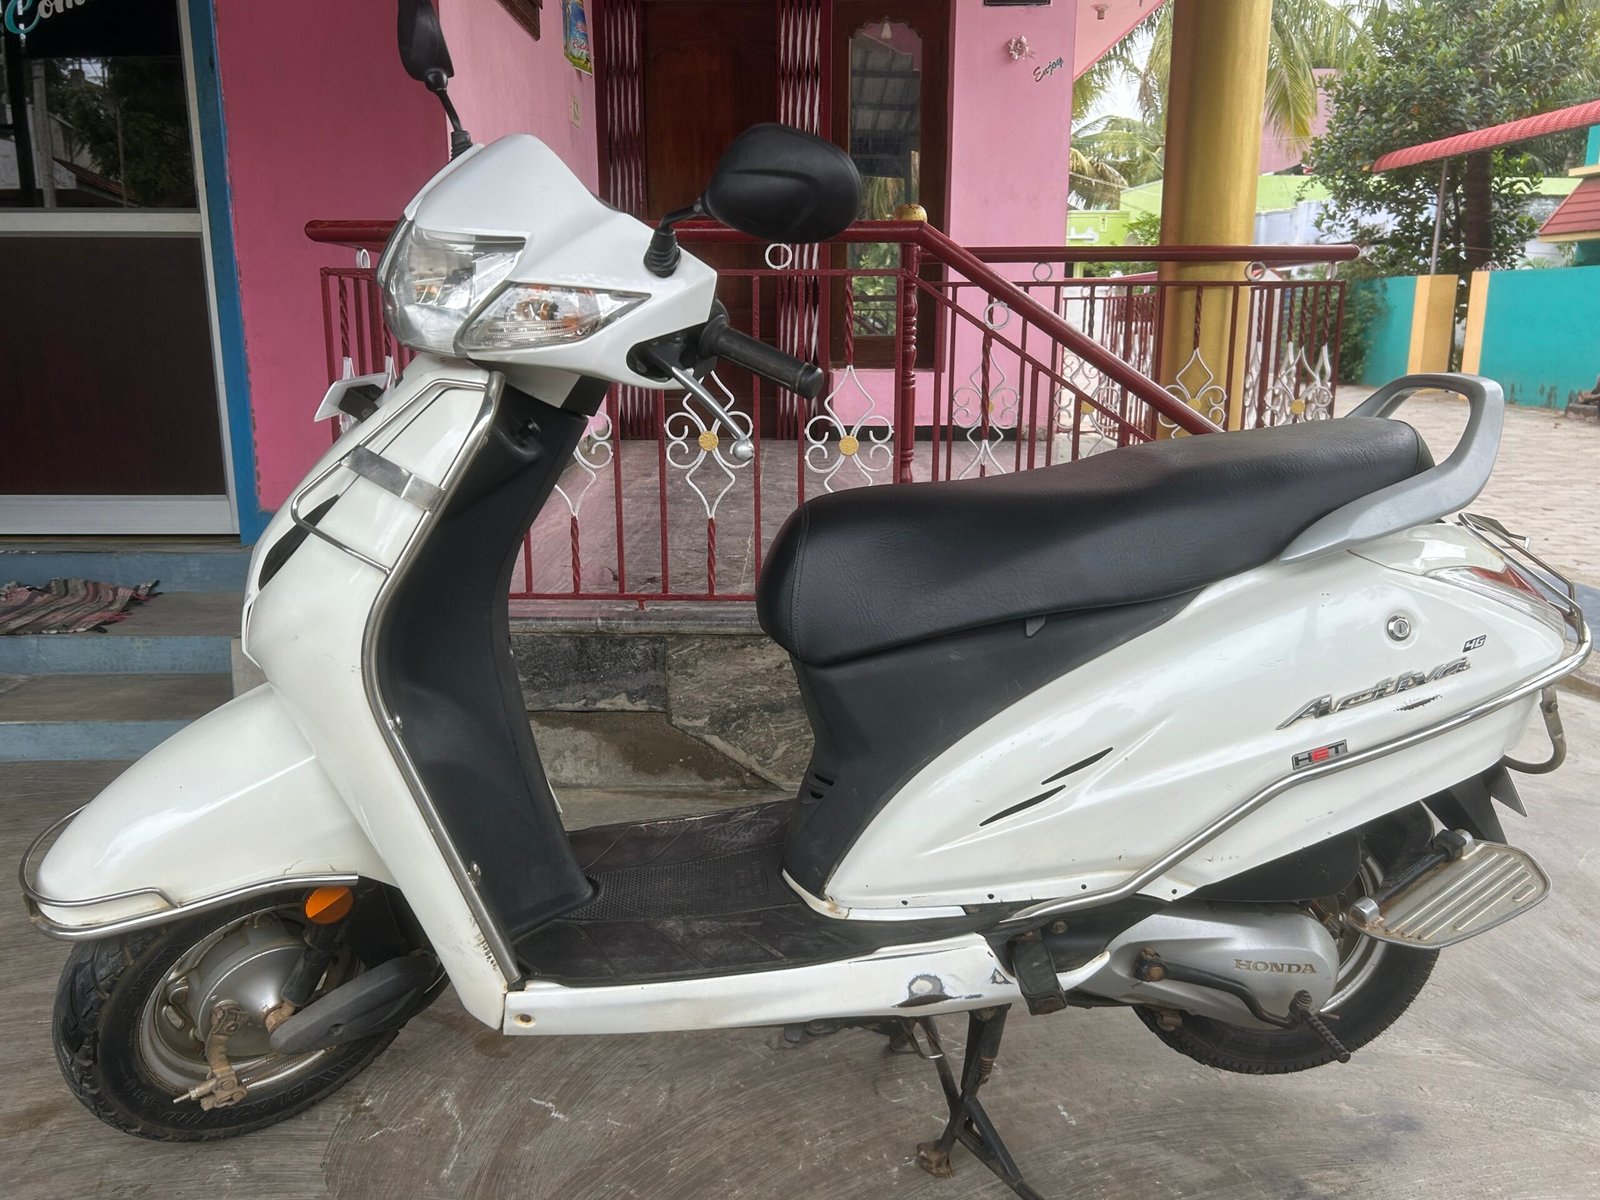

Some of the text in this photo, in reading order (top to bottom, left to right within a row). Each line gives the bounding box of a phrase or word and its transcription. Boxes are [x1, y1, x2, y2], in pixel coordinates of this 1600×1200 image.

[1033, 57, 1063, 82] Enjoy
[1463, 635, 1486, 651] 4G
[1276, 656, 1471, 730] Activa
[1293, 741, 1346, 767] HET
[1233, 959, 1318, 974] HONDA
